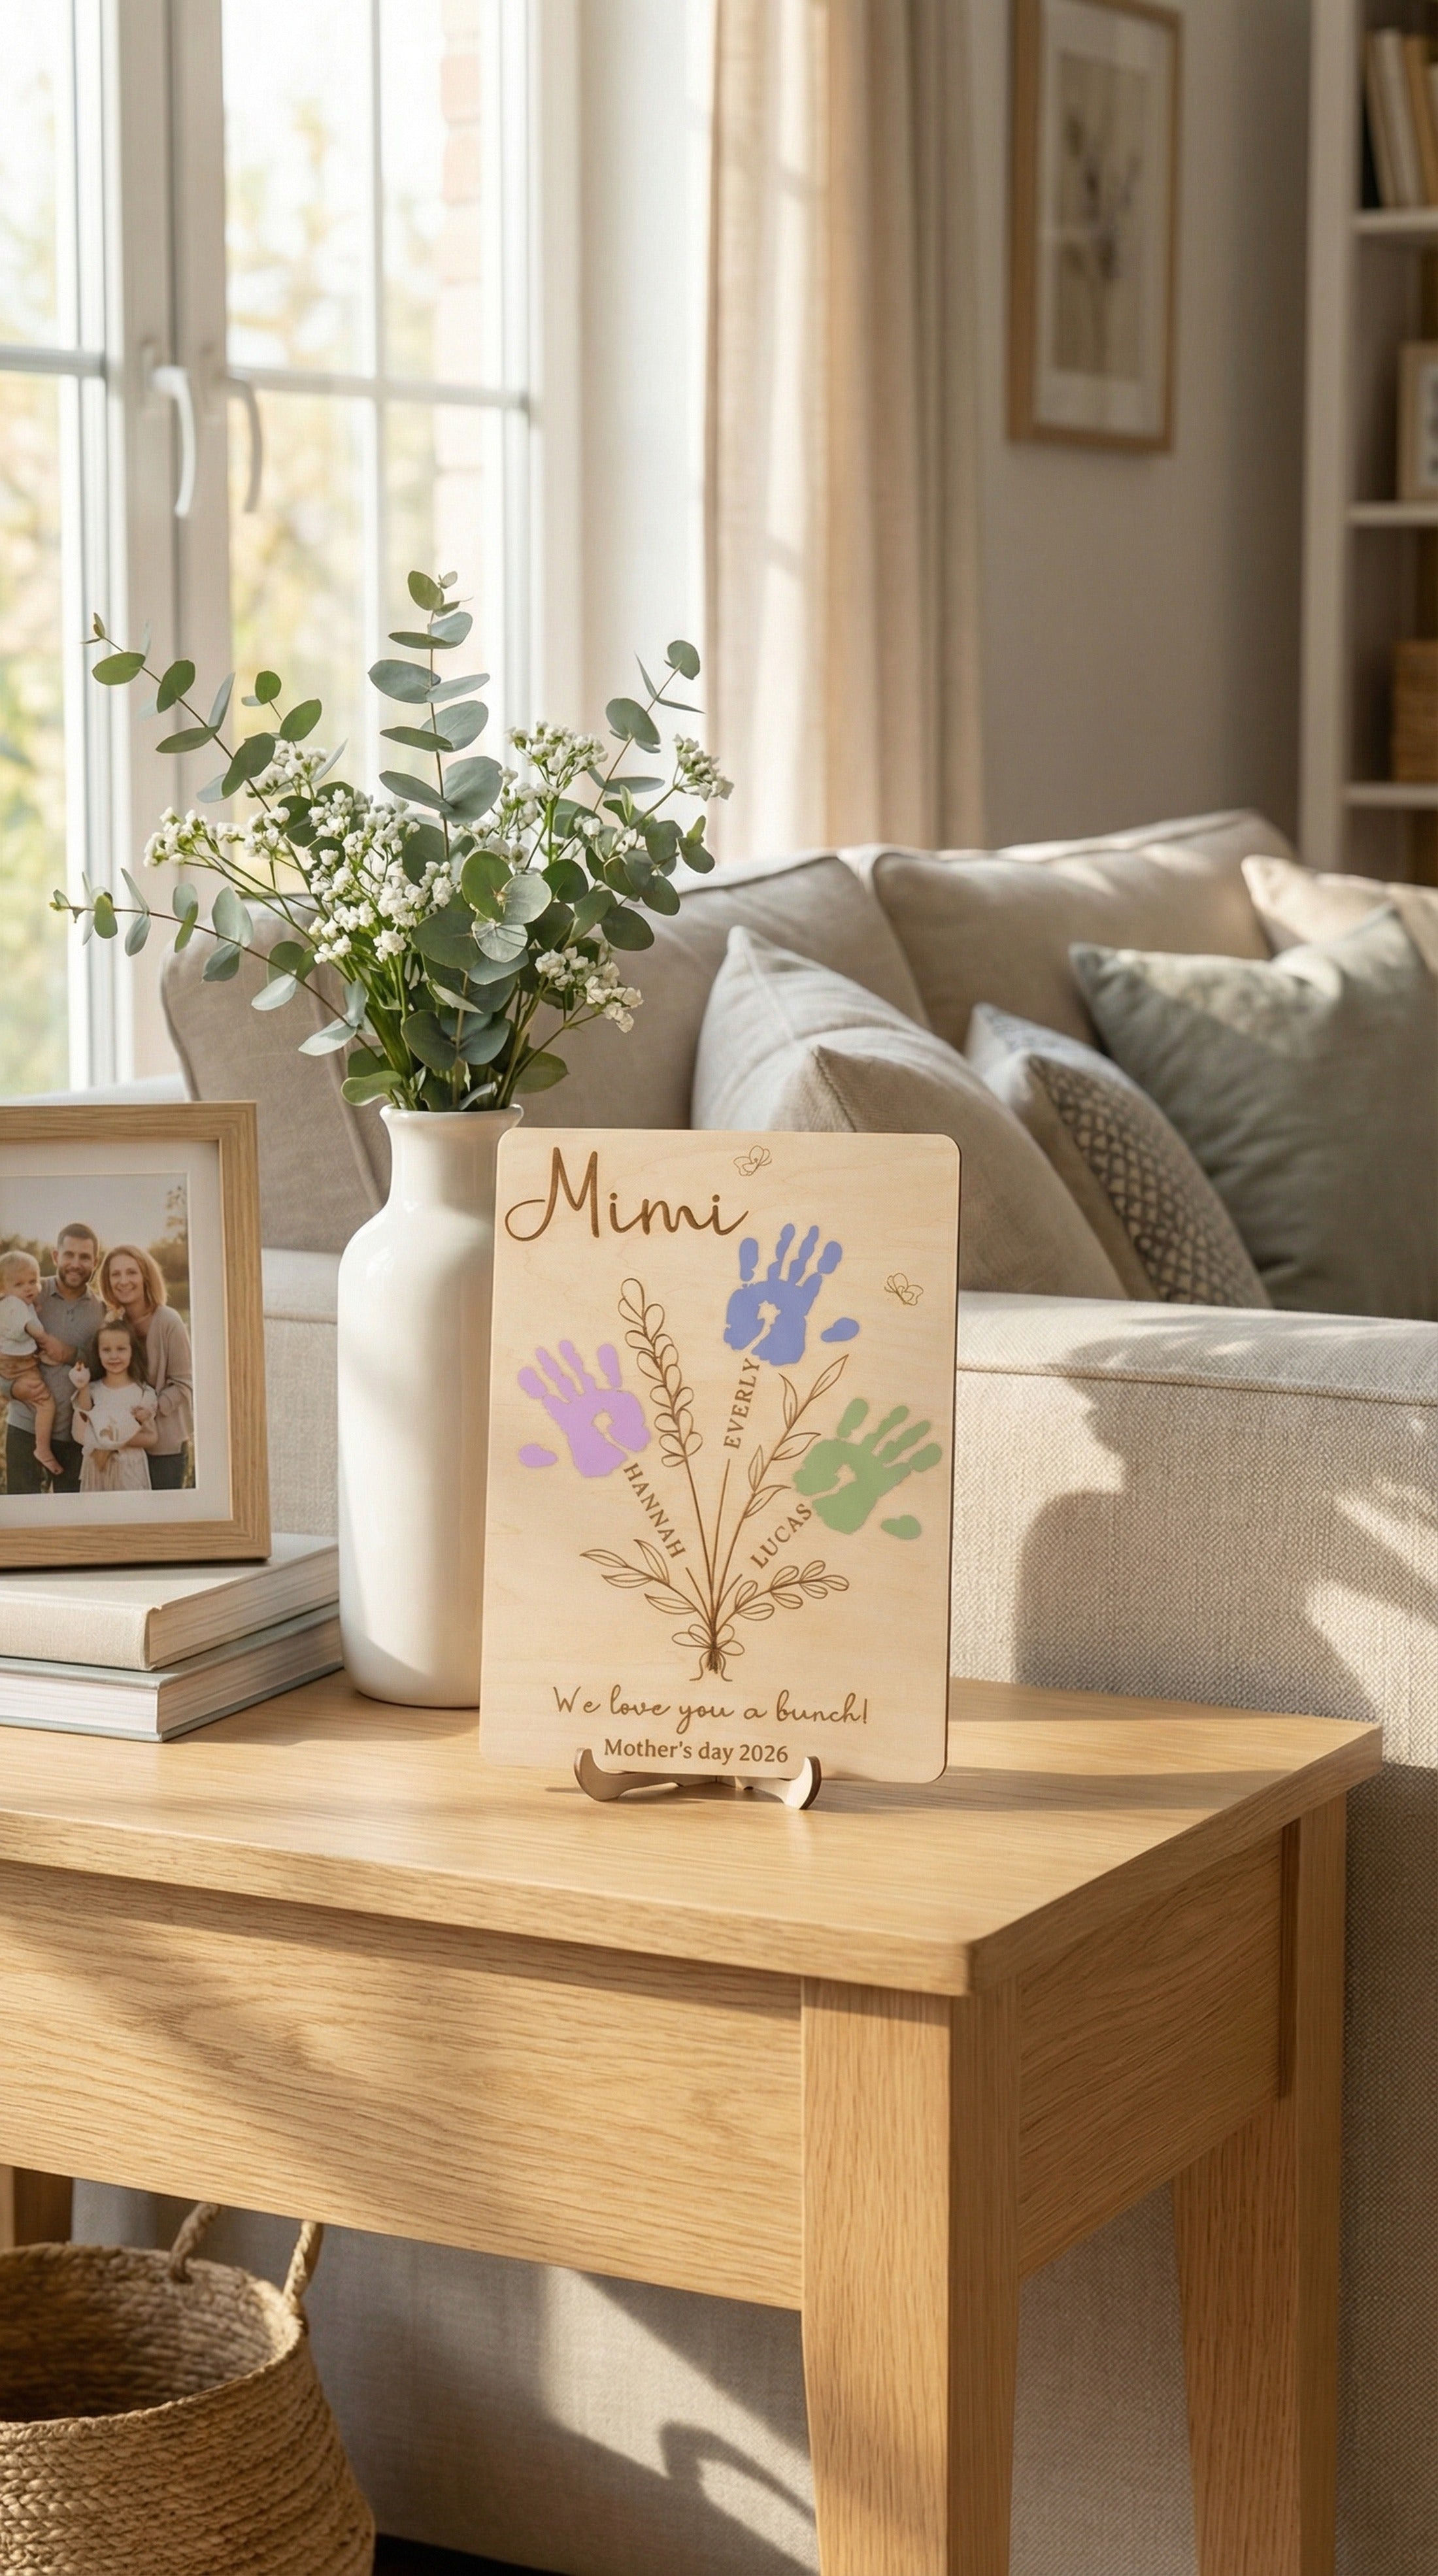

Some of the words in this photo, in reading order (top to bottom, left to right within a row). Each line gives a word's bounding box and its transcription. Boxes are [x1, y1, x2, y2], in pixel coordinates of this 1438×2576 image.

[505, 1147, 750, 1242] Mimi
[724, 1358, 760, 1449] EVERLY
[623, 1462, 686, 1559] HANNAH
[750, 1502, 812, 1570] LUCAS
[553, 1685, 601, 1714] We
[610, 1685, 671, 1717] love
[677, 1704, 735, 1734] you
[743, 1704, 768, 1719] a
[777, 1690, 868, 1725] bunch!
[604, 1739, 693, 1760] Mother's
[698, 1742, 733, 1766] day
[739, 1743, 788, 1763] 2026
